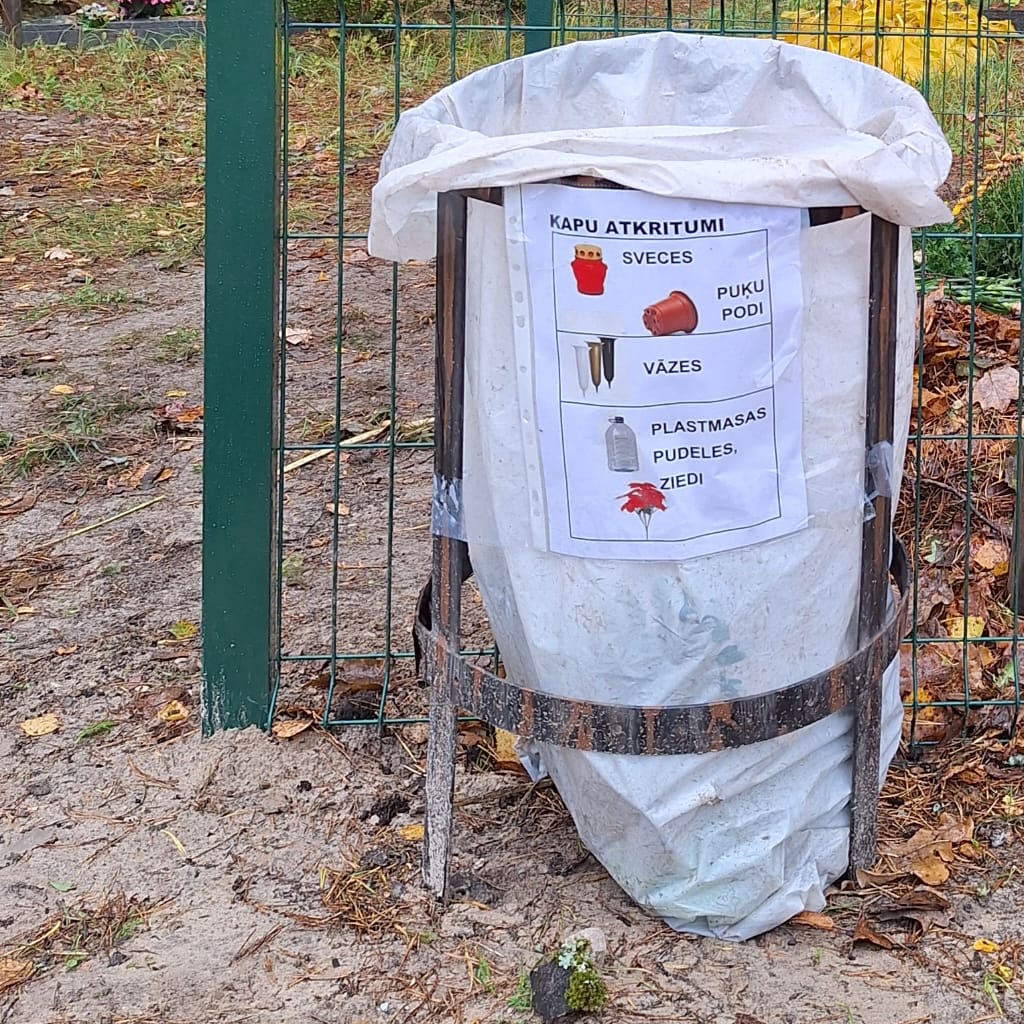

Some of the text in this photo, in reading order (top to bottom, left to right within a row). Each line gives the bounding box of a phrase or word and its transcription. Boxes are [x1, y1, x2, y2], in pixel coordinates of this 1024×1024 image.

[549, 214, 725, 235] KAPU ATKRITUMI
[622, 250, 693, 265] SVECES
[717, 279, 765, 300] PUĶU
[722, 301, 764, 321] PODI
[643, 358, 702, 375] VĀZES
[651, 407, 768, 436] PLASTMASAS
[653, 442, 738, 464] PUDELES,
[659, 472, 703, 491] ZIEDI
